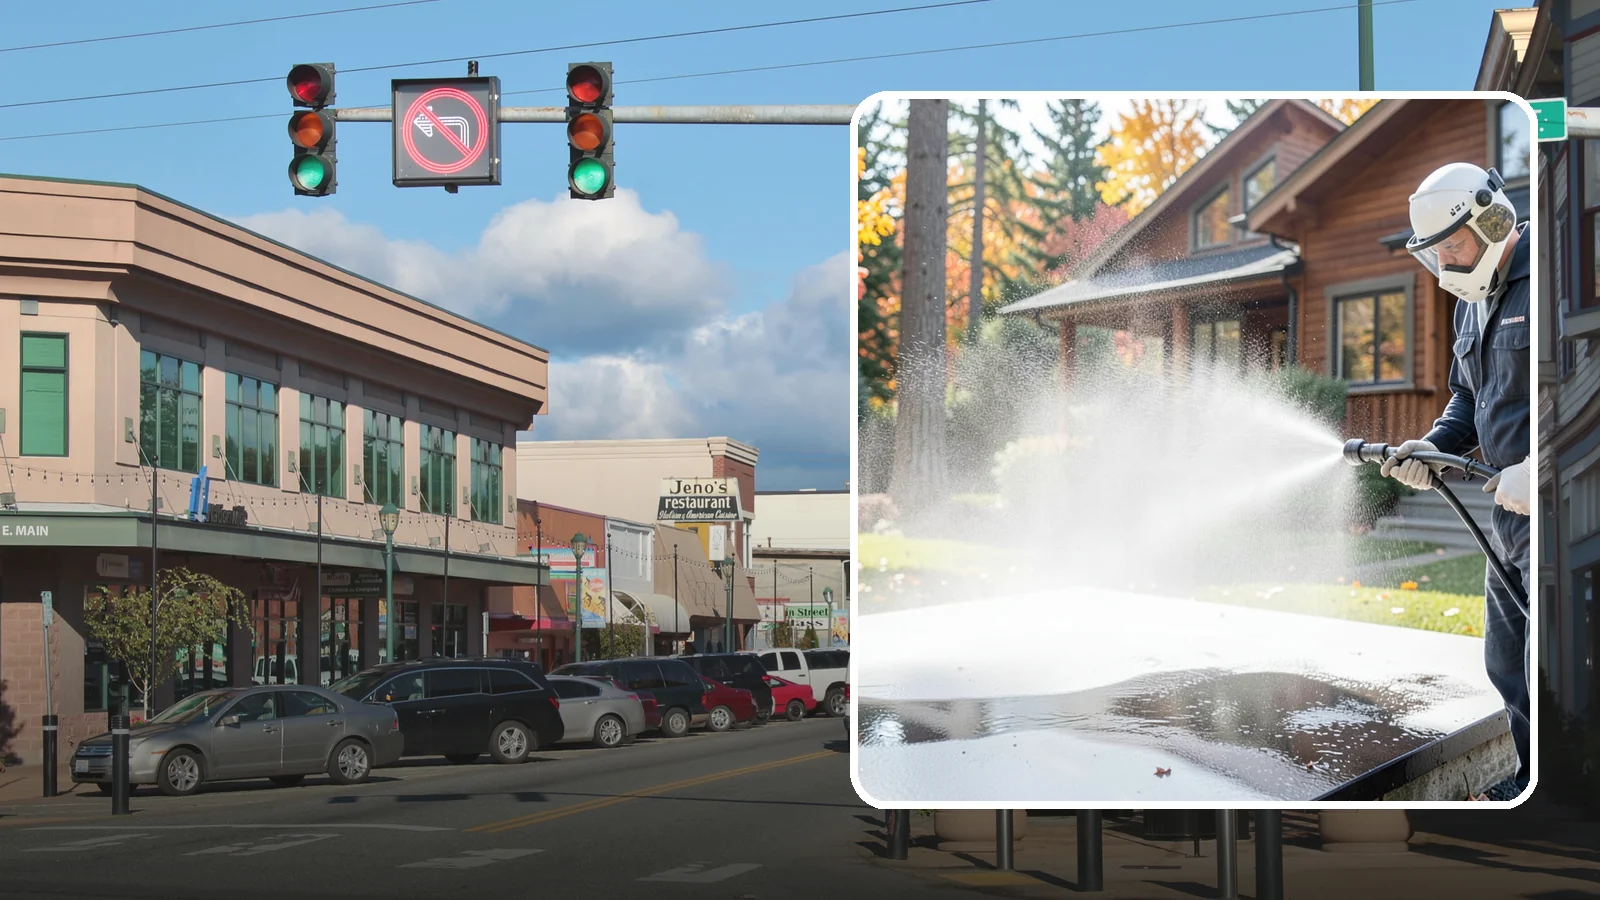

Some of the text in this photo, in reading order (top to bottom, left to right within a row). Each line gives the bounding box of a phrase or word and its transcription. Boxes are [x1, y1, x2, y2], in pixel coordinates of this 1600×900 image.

[669, 480, 728, 494] Jeno's
[665, 497, 731, 509] restaurant
[658, 510, 681, 520] Italian
[685, 510, 714, 519] American
[714, 509, 738, 519] Cuisine
[2, 525, 49, 536] E. MAIN
[785, 607, 829, 617] in Street
